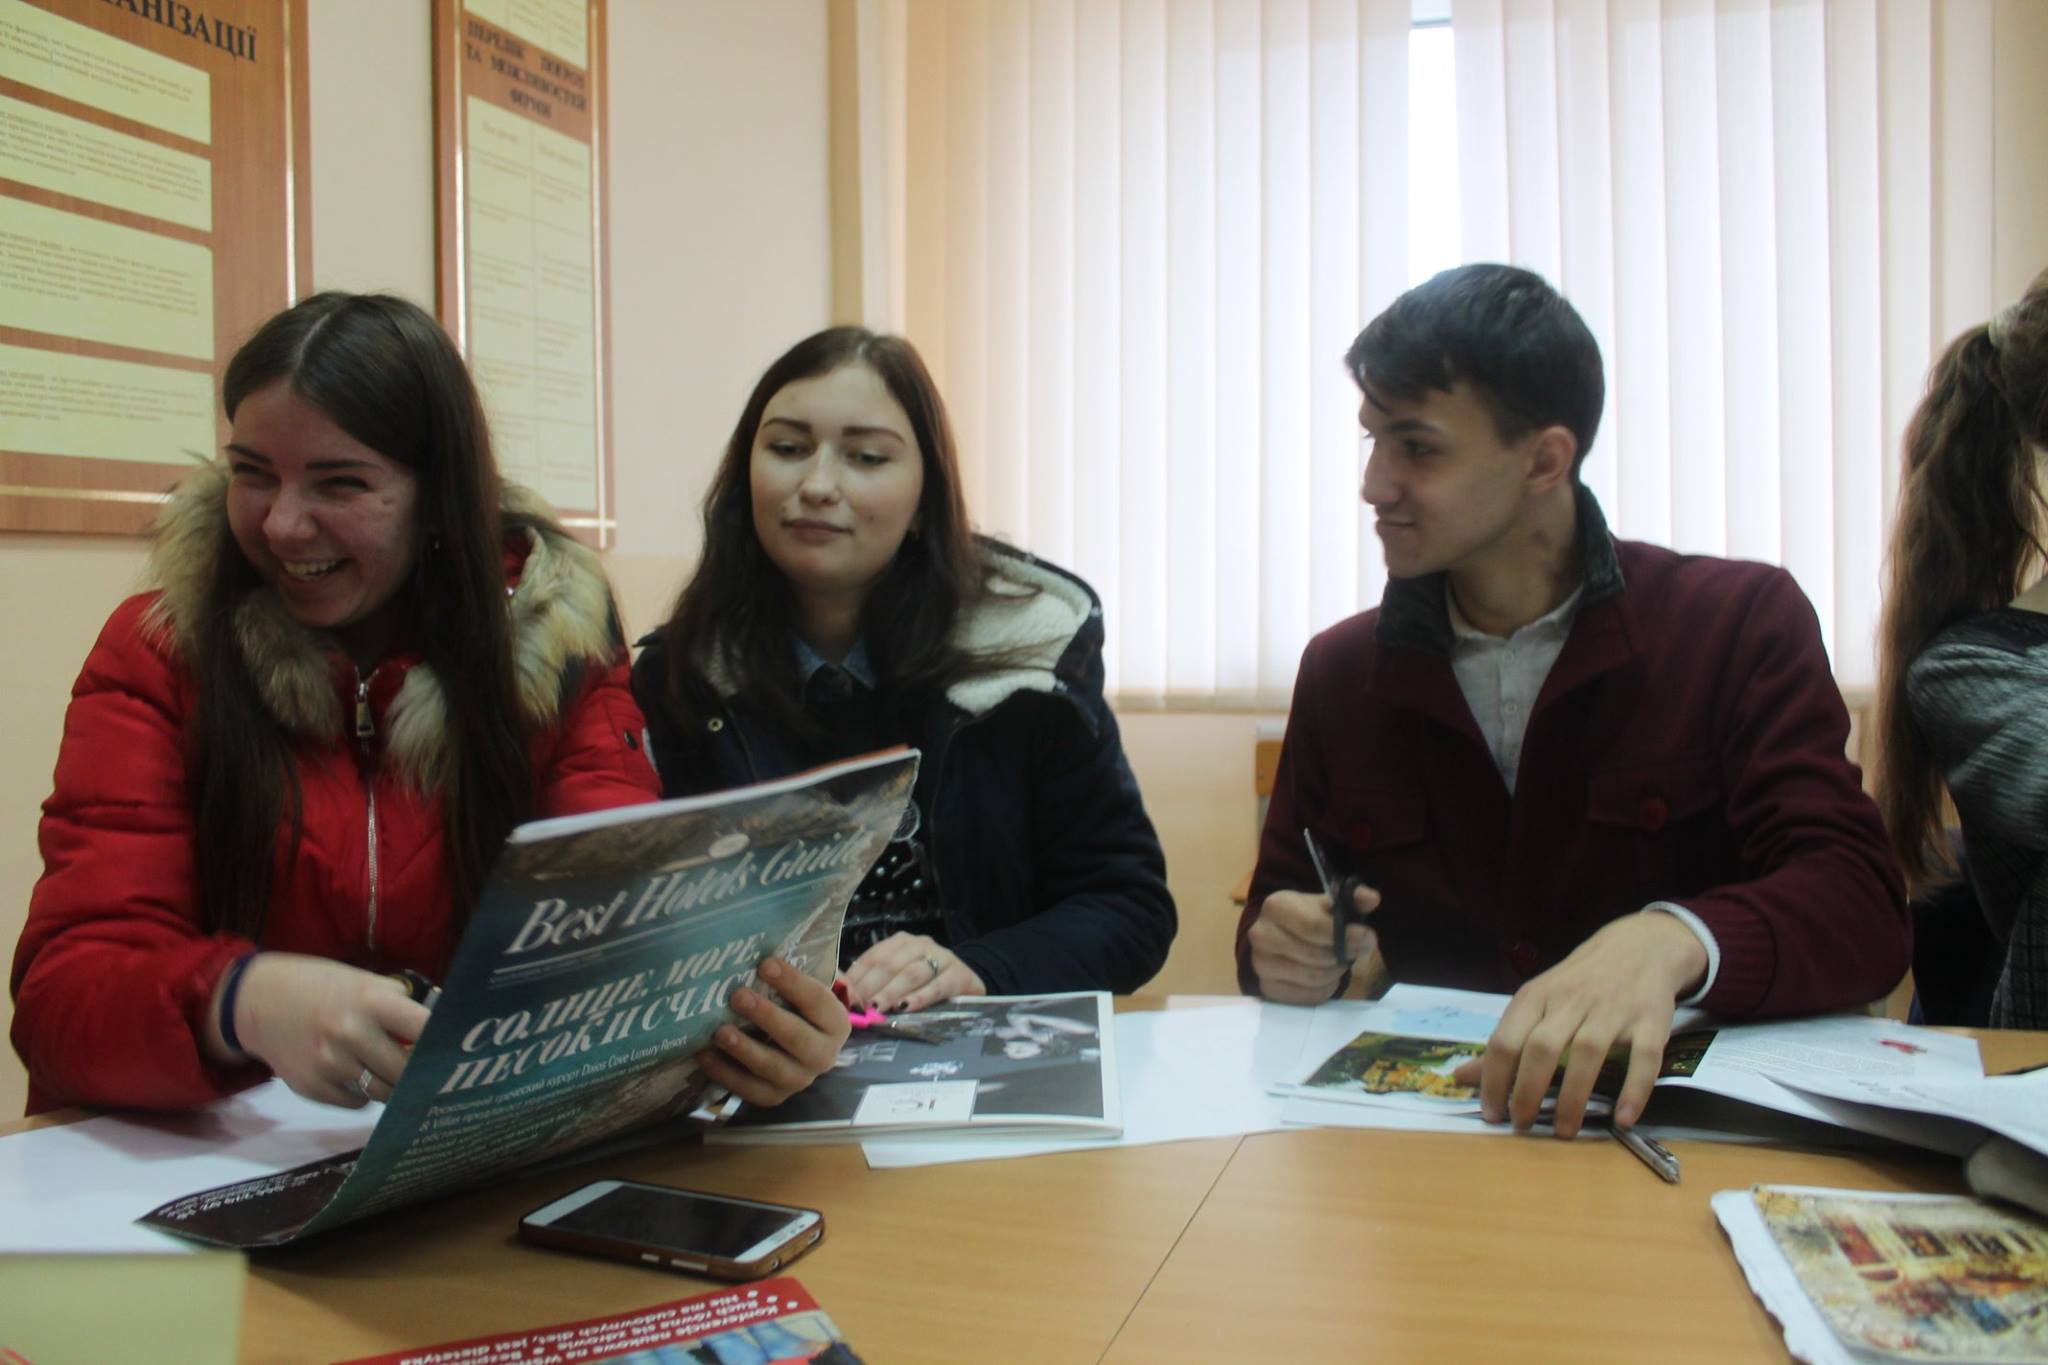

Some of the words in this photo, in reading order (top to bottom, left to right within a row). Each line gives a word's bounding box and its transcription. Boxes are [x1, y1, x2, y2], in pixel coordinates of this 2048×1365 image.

[504, 890, 628, 954] Best
[623, 851, 757, 927] Hotels
[437, 1018, 597, 1094] ПЕСОК
[601, 1005, 641, 1045] И
[631, 1046, 658, 1062] Luxury
[661, 1035, 688, 1052] Resort
[680, 1302, 706, 1316] ma
[709, 1293, 740, 1308] Nie
[716, 1300, 759, 1317] Ruch
[579, 1308, 677, 1337] cudownych
[676, 1305, 778, 1336] Konferencje
[494, 1337, 527, 1352] jest
[557, 1331, 627, 1350] zdrowie
[593, 1331, 671, 1354] naukowe
[566, 1349, 588, 1360] na
